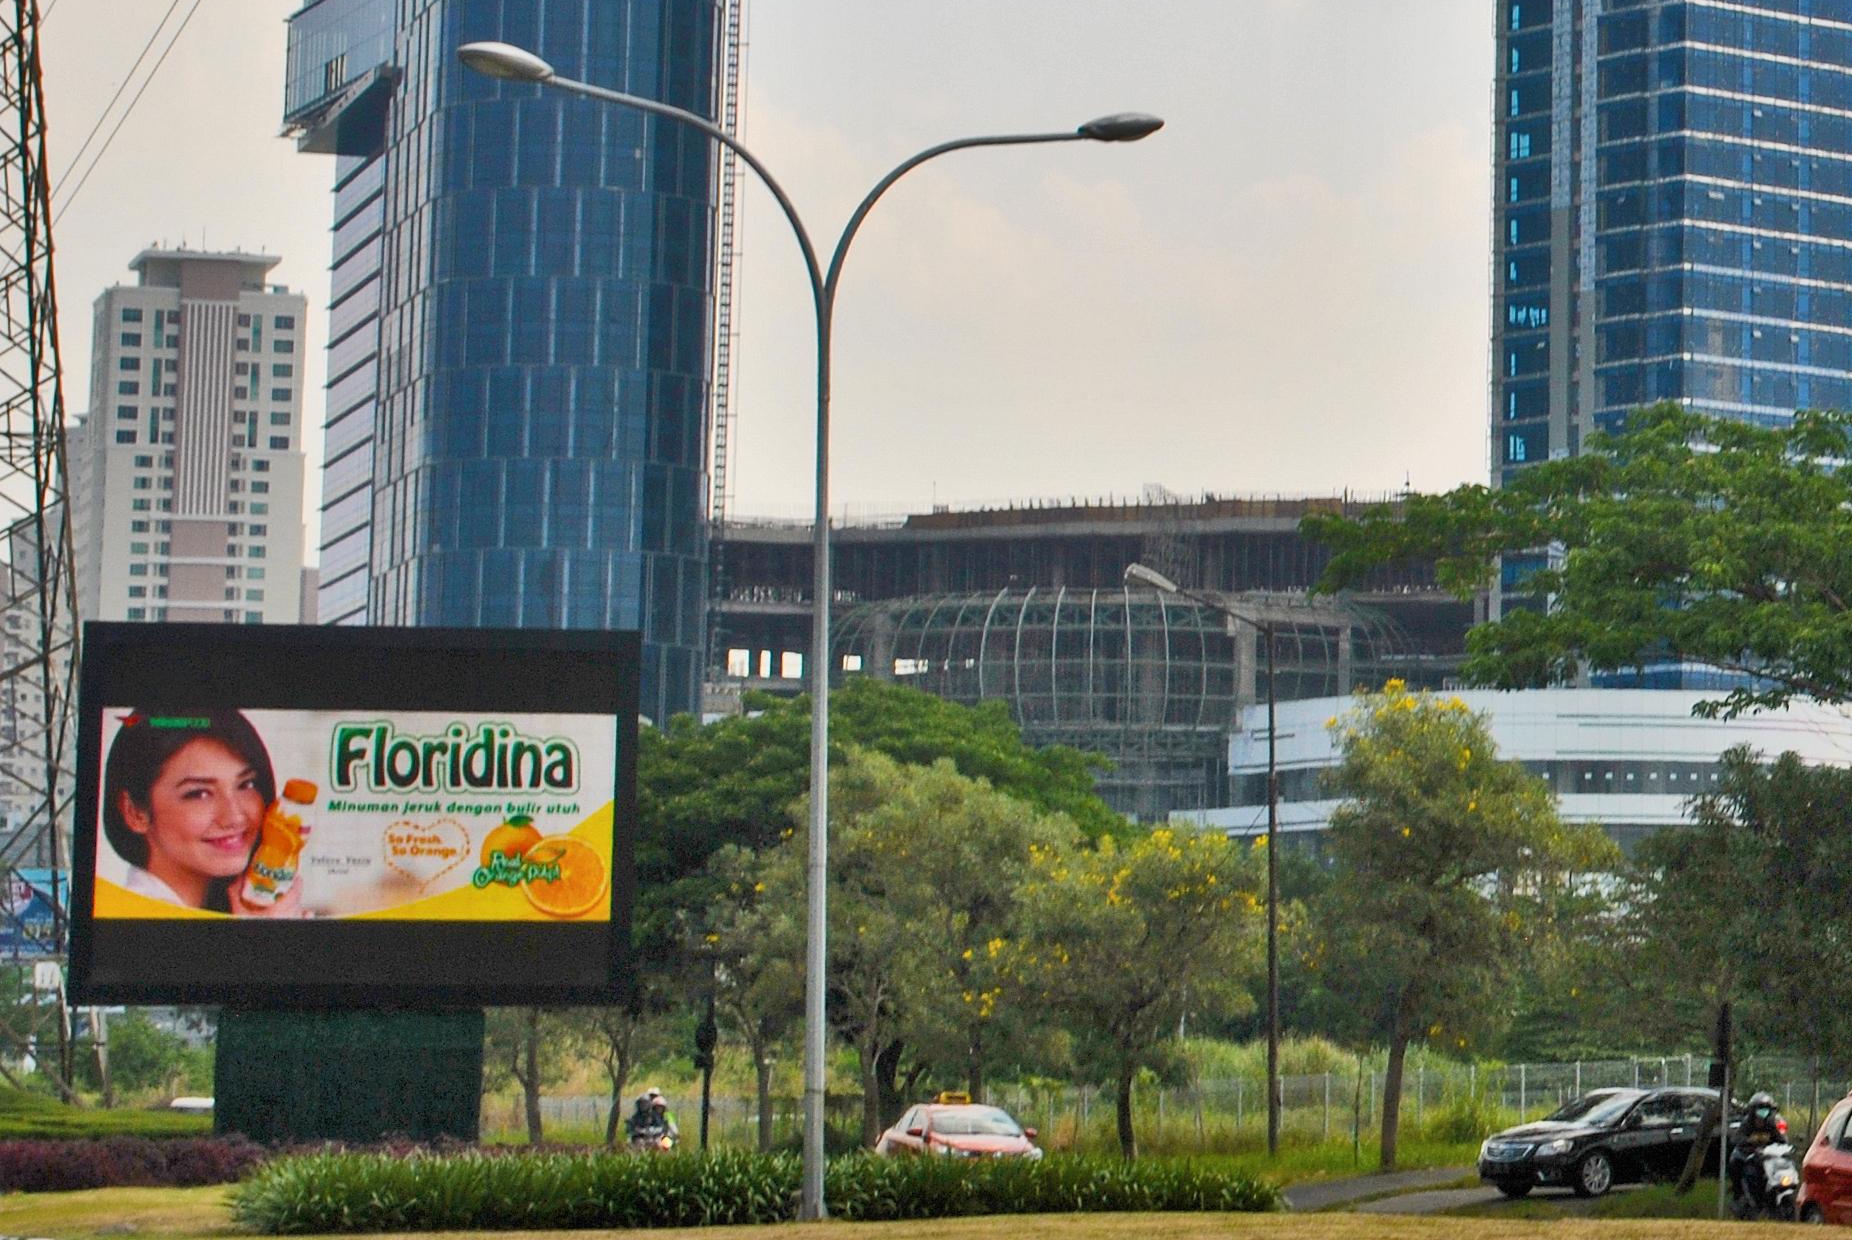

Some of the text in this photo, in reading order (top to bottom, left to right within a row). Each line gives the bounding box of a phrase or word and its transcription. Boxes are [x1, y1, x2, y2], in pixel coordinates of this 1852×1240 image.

[334, 724, 575, 790] Floridina
[327, 800, 399, 813] Minuman
[402, 800, 442, 816] jeruk
[446, 801, 502, 816] dengan
[546, 802, 580, 814] utuh
[392, 846, 457, 860] So Orange
